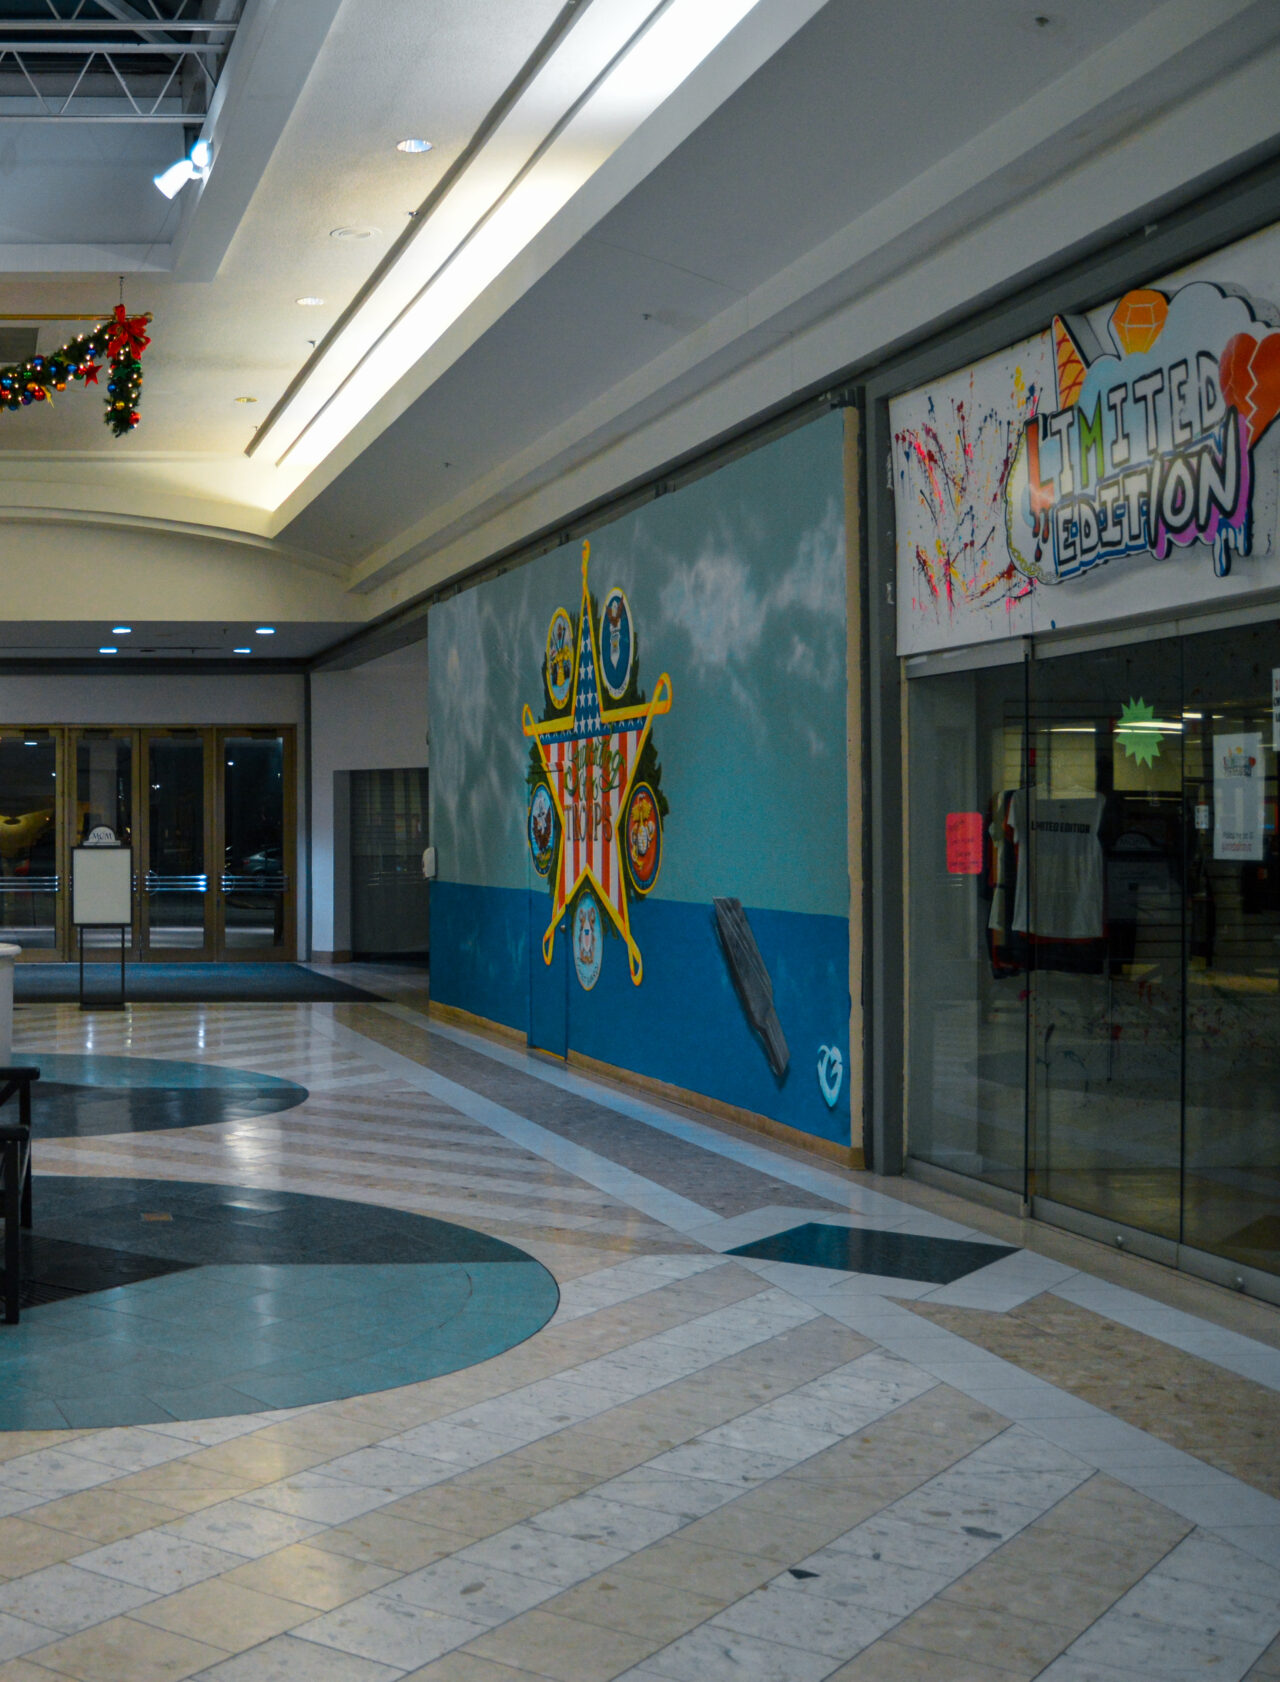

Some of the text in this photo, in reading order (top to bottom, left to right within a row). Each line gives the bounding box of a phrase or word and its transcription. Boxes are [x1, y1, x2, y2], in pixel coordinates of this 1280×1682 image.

[1025, 350, 1230, 512] LIMITED
[1054, 406, 1241, 565] EDITION
[564, 801, 613, 843] TROOPS
[1060, 822, 1091, 834] EDITION
